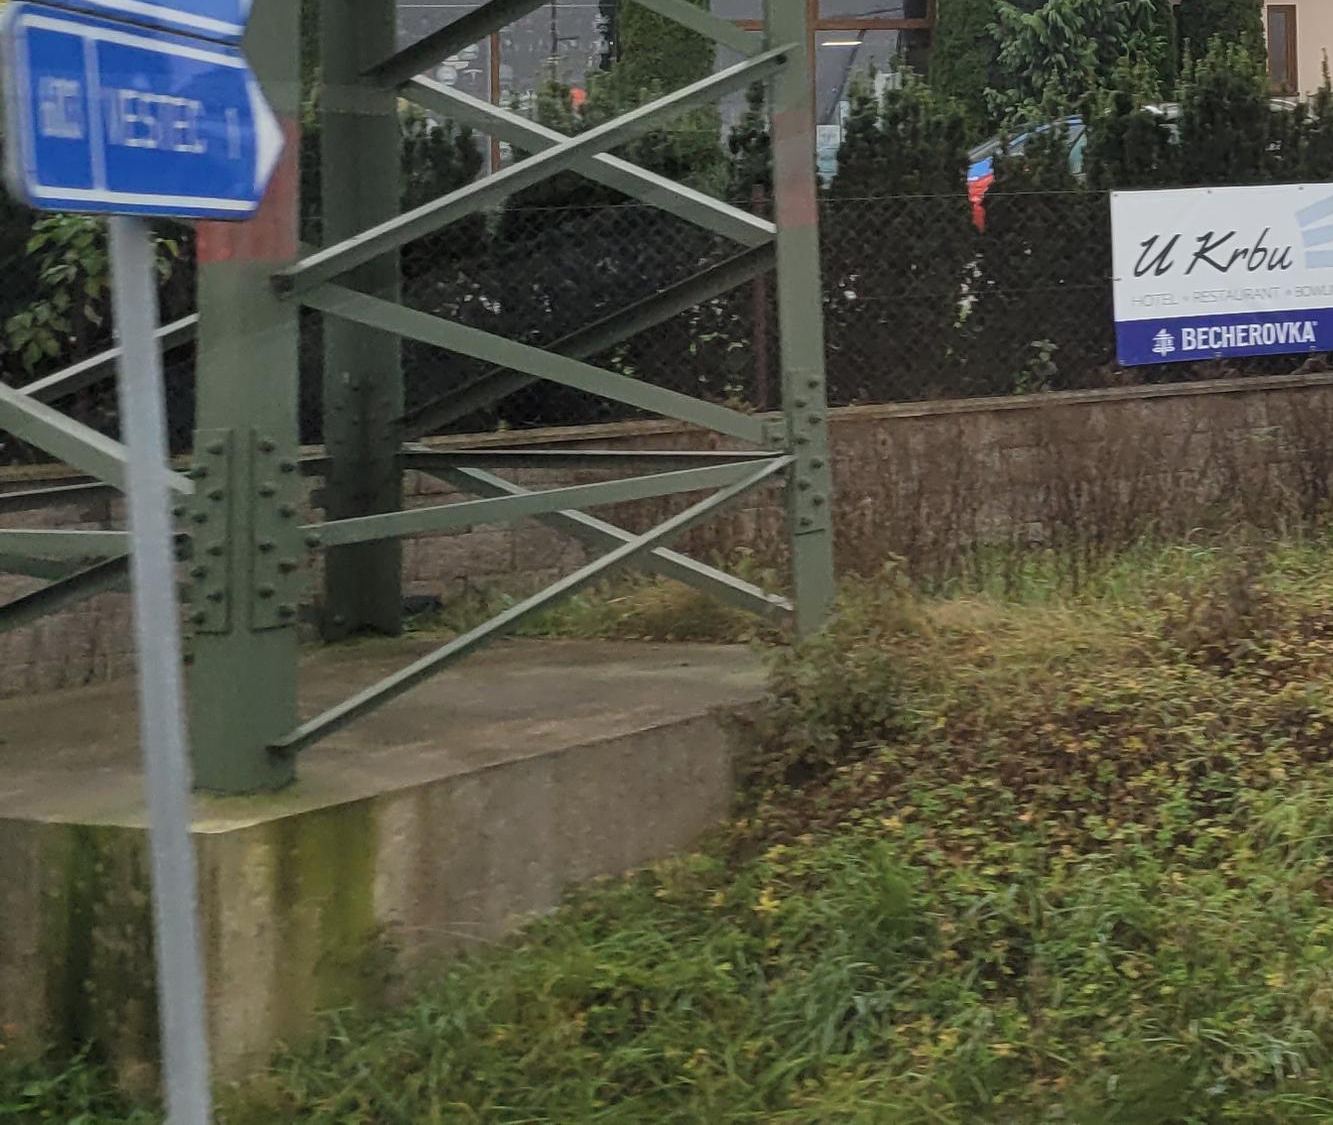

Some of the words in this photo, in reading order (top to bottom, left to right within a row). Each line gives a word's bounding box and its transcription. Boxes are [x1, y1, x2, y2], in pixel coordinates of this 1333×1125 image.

[1133, 233, 1181, 278] U
[1184, 227, 1293, 275] Krbu
[1131, 292, 1178, 308] HOTEL
[1193, 286, 1280, 303] RESTAURANT
[1181, 320, 1317, 351] BECHEROVKA
